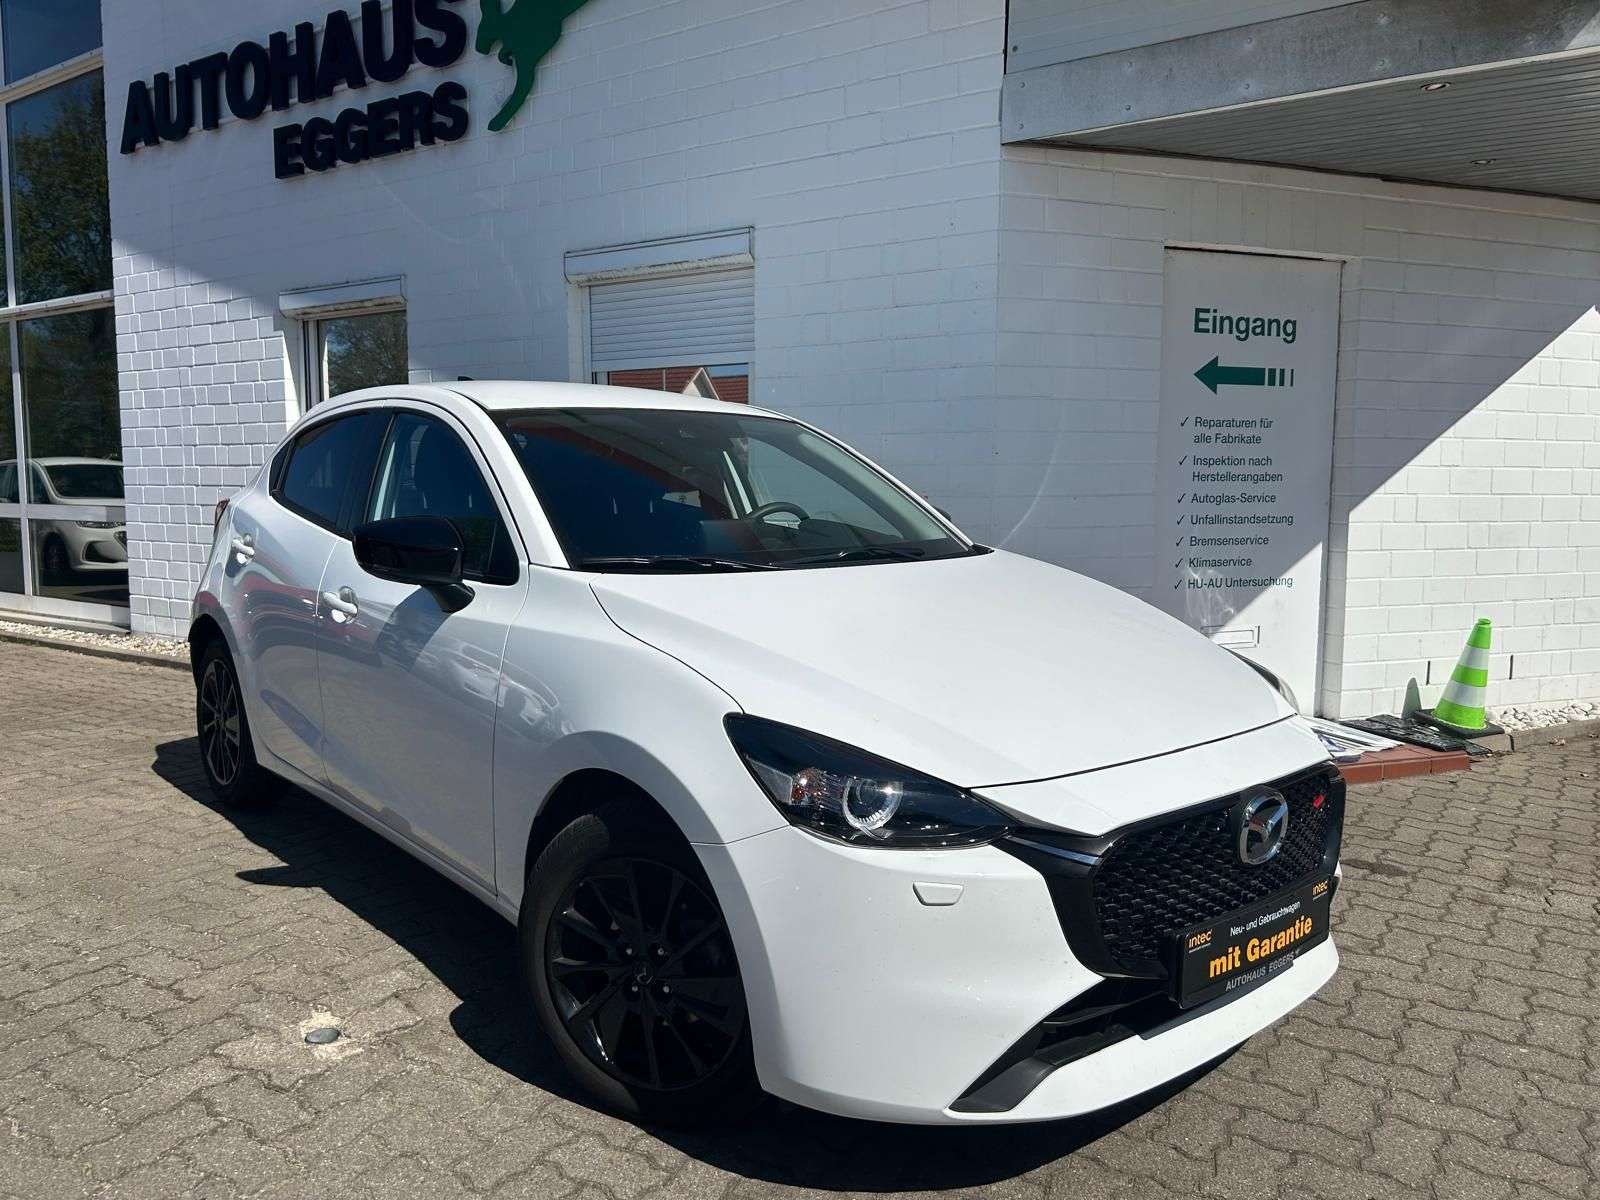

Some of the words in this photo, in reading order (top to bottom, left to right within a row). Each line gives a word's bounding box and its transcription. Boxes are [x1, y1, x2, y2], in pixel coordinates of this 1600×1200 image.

[120, 0, 468, 154] AUTOHAUS
[273, 81, 468, 179] EGGERS
[1194, 307, 1297, 344] Eingang
[1194, 416, 1257, 429] Reparaturen
[1260, 417, 1273, 428] für
[1194, 433, 1212, 443] alle
[1215, 433, 1262, 444] Fabrikate
[1193, 456, 1245, 467] Inspektion
[1248, 456, 1272, 466] nach
[1192, 471, 1283, 484] Herstellerangaben
[1191, 493, 1276, 505] Autoglas-Service
[1190, 513, 1294, 525] Unfallinstandsetzung
[1189, 536, 1269, 547] Bremsenservice
[1188, 556, 1252, 567] Klimaservice
[1187, 577, 1223, 589] HU-AU
[1225, 576, 1294, 588] Untersuchung
[1312, 880, 1328, 896] intec
[1229, 926, 1246, 937] Neu-
[1246, 919, 1258, 931] und
[1258, 901, 1301, 925] Gebrauchtwagen
[1188, 929, 1213, 949] intec
[1209, 945, 1241, 978] mit
[1246, 915, 1313, 962] Garantie
[1225, 966, 1267, 991] AUTOHAUS
[1268, 953, 1295, 973] EGGERS
